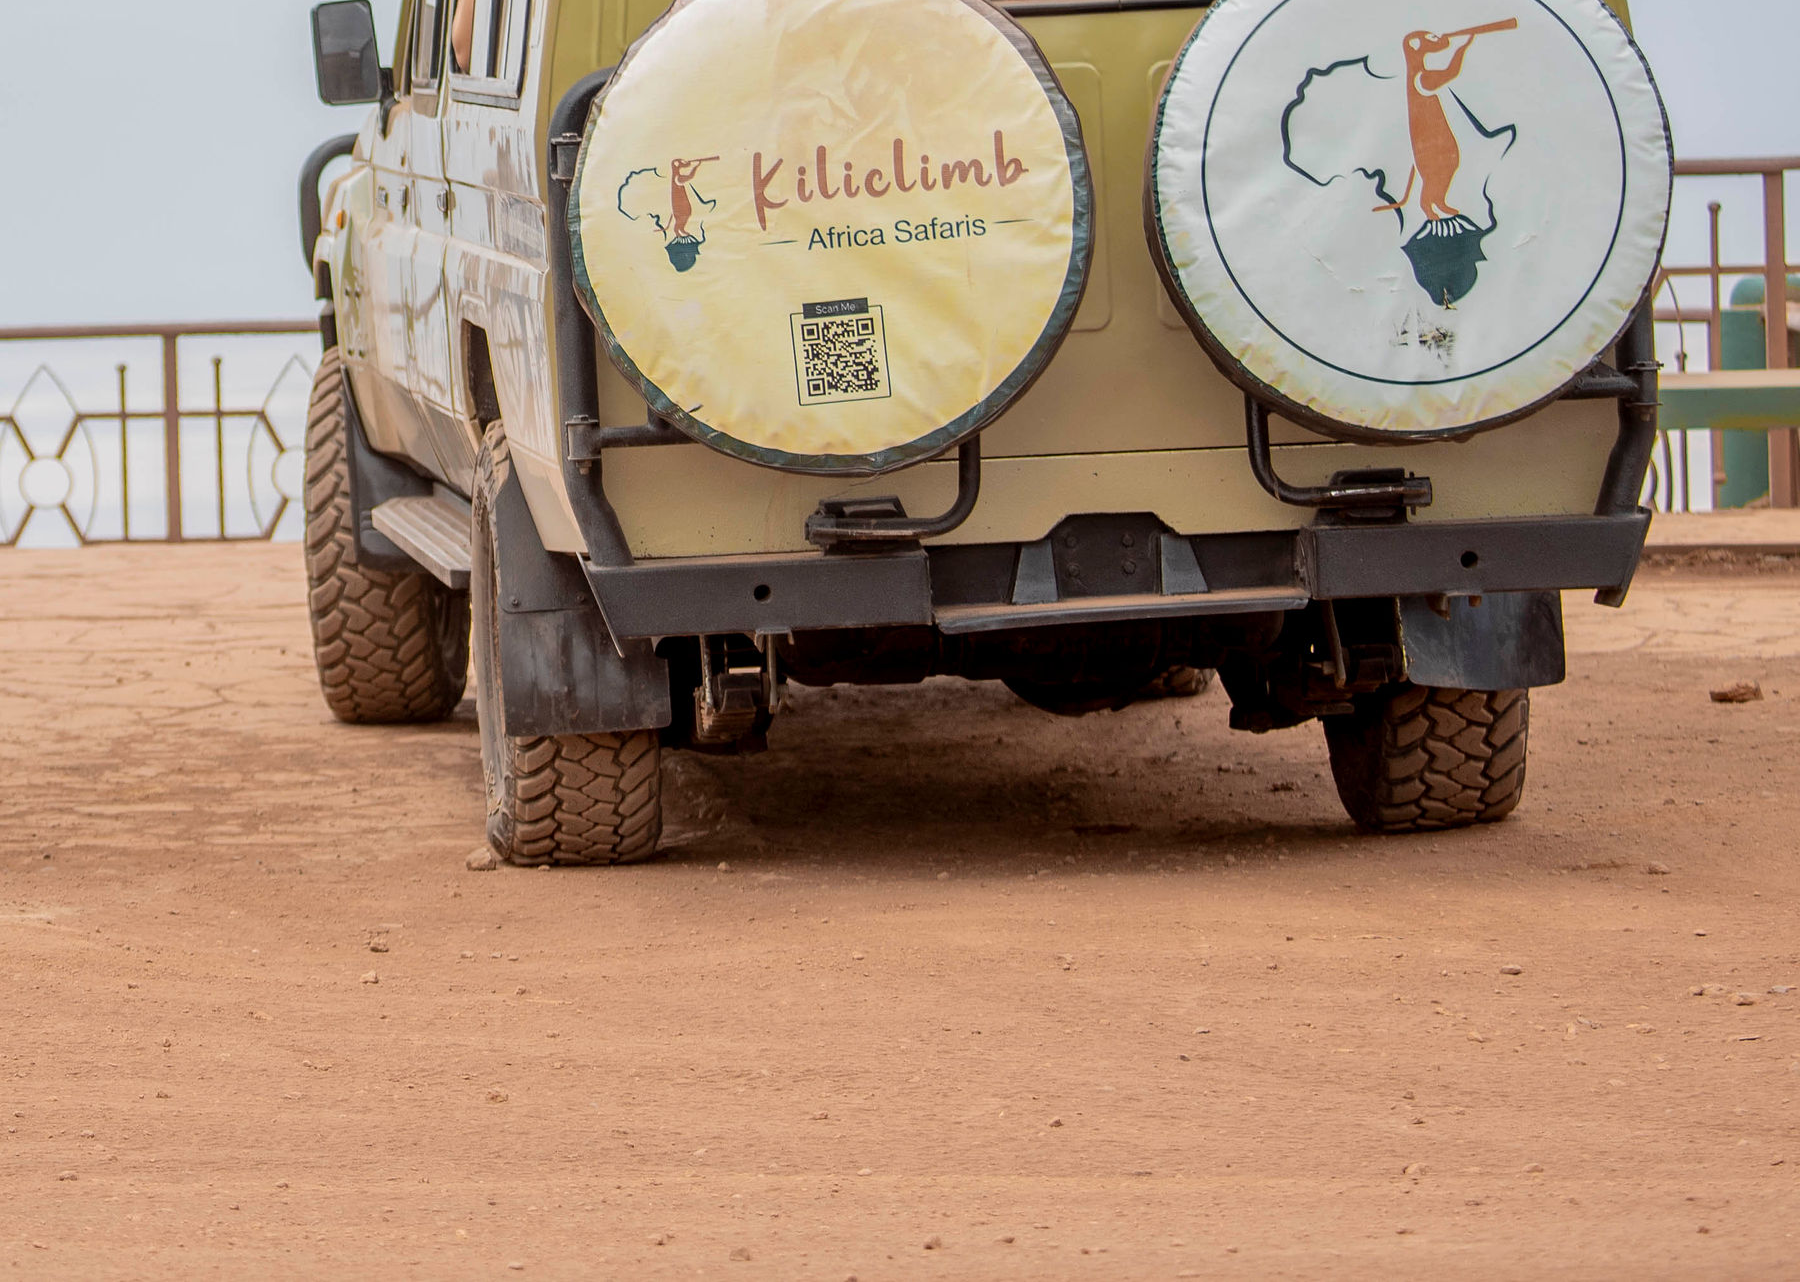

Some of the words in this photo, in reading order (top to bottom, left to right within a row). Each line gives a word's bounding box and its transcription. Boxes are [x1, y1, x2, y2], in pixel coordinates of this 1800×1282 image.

[752, 130, 1029, 232] Kiliclimb
[807, 226, 886, 251] Africa
[894, 215, 987, 244] Safaris
[815, 305, 839, 315] Scan
[841, 302, 856, 311] Me
